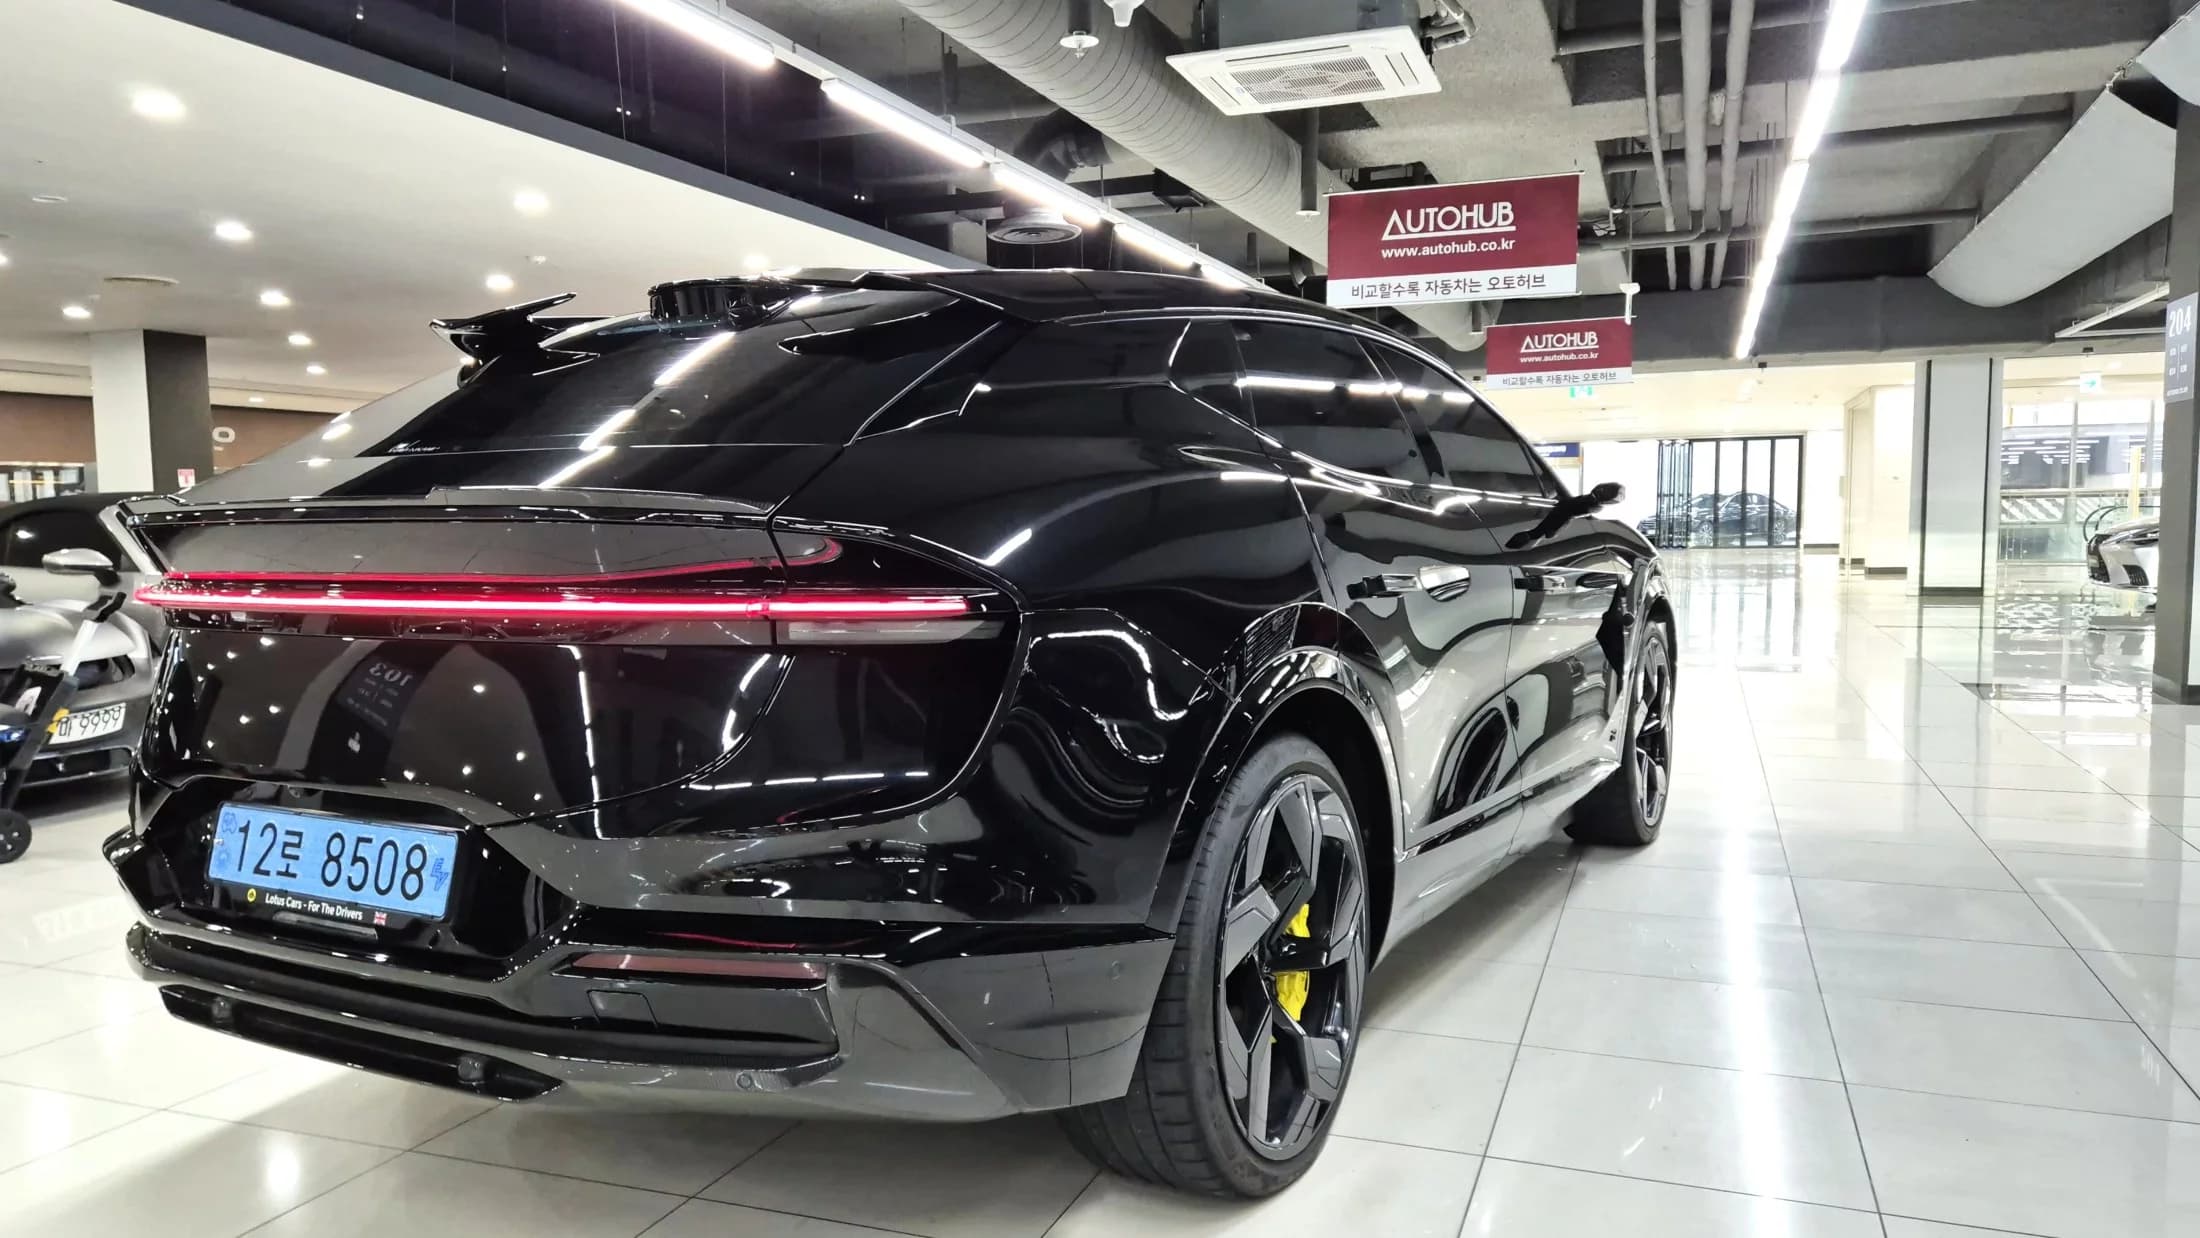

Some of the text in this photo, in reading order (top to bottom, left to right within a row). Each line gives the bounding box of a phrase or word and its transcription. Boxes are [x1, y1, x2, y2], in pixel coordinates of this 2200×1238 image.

[1381, 201, 1516, 241] AUTOHUB
[1381, 238, 1515, 259] www.autohub.co.kr
[1351, 273, 1547, 300] 비교할수록 자동차는 오토허브
[2168, 304, 2192, 338] 204
[1520, 331, 1599, 353] AUTOHUB
[1520, 352, 1599, 363] www.autohub.co.kr
[237, 820, 427, 901] 12로 8508
[265, 893, 285, 905] Lotus
[286, 897, 302, 909] Cars
[308, 901, 320, 912] For
[321, 903, 335, 916] The
[335, 906, 363, 920] Drivers
